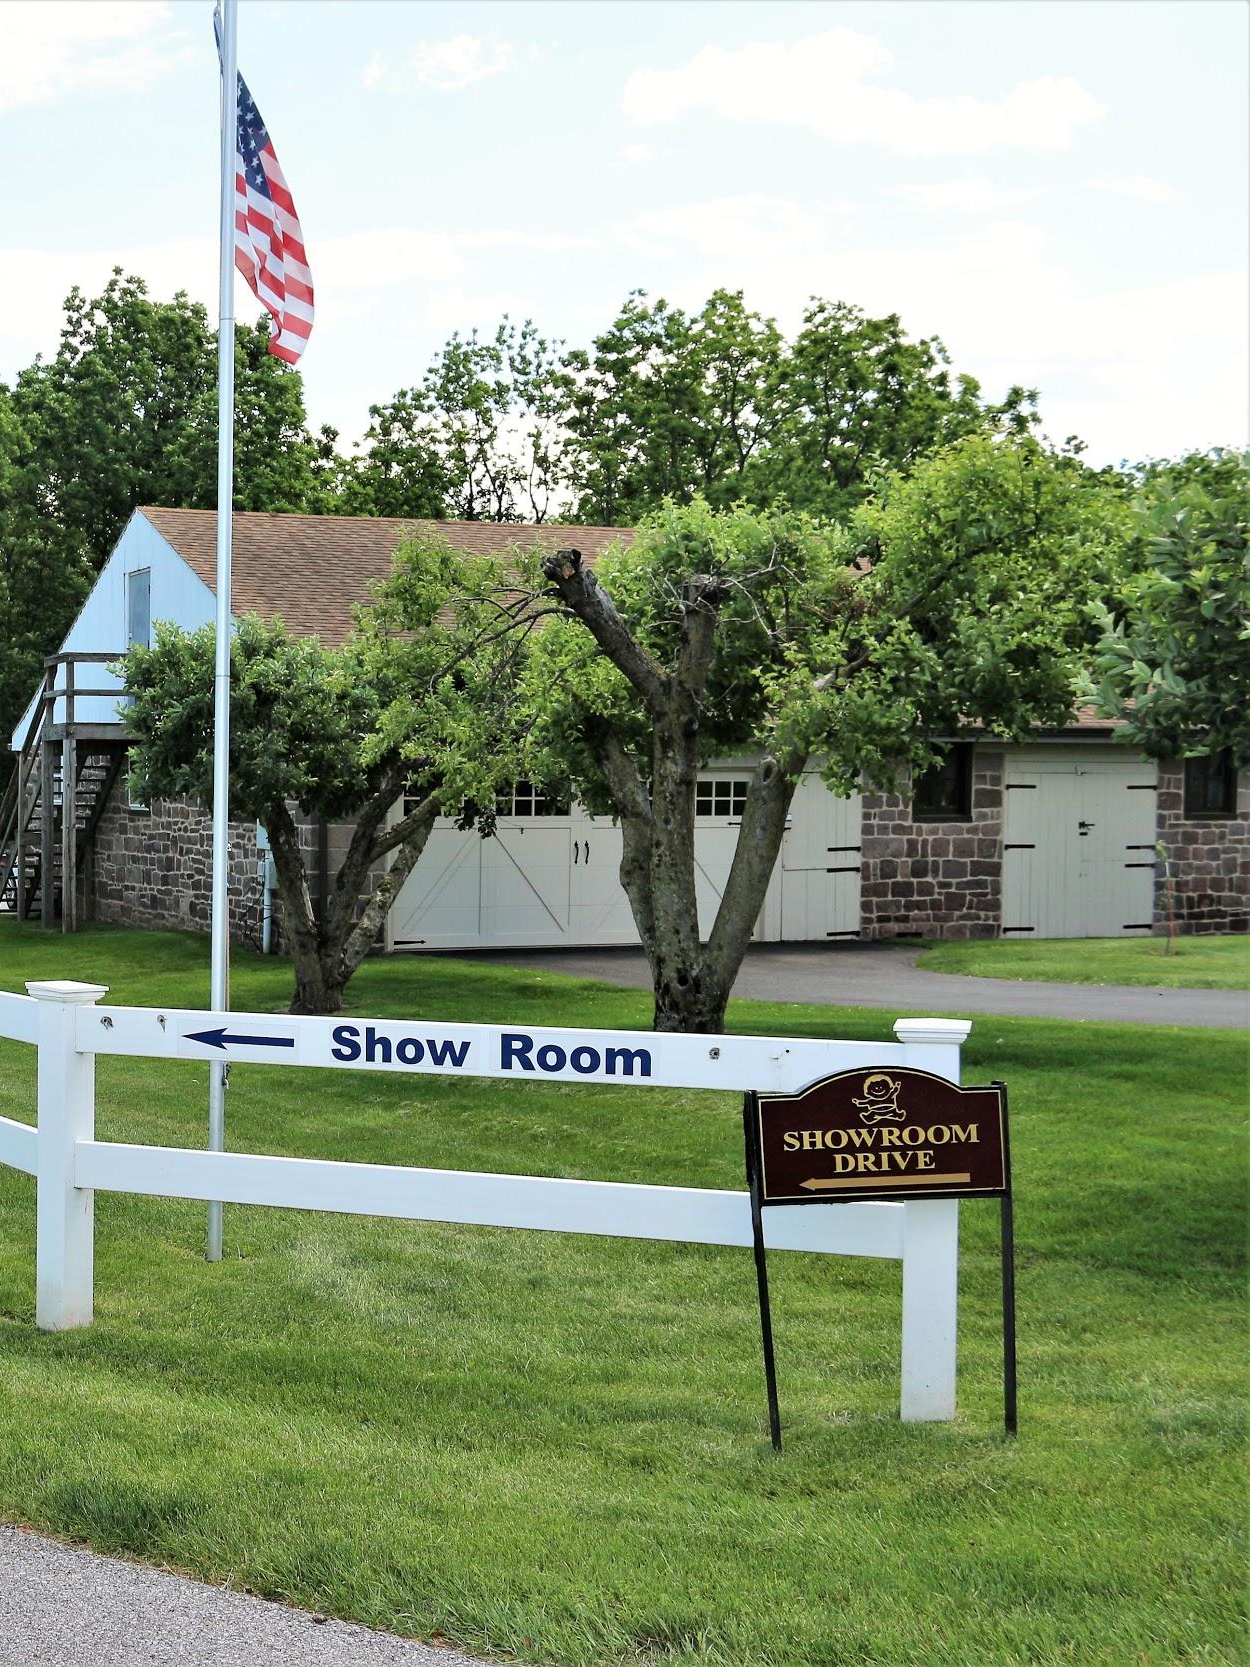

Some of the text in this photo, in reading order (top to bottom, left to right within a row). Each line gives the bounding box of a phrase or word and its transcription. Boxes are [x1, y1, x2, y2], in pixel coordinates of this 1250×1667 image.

[331, 1024, 652, 1077] Show Room
[783, 1123, 980, 1152] SHOWROOM
[833, 1150, 936, 1173] DRIVE
